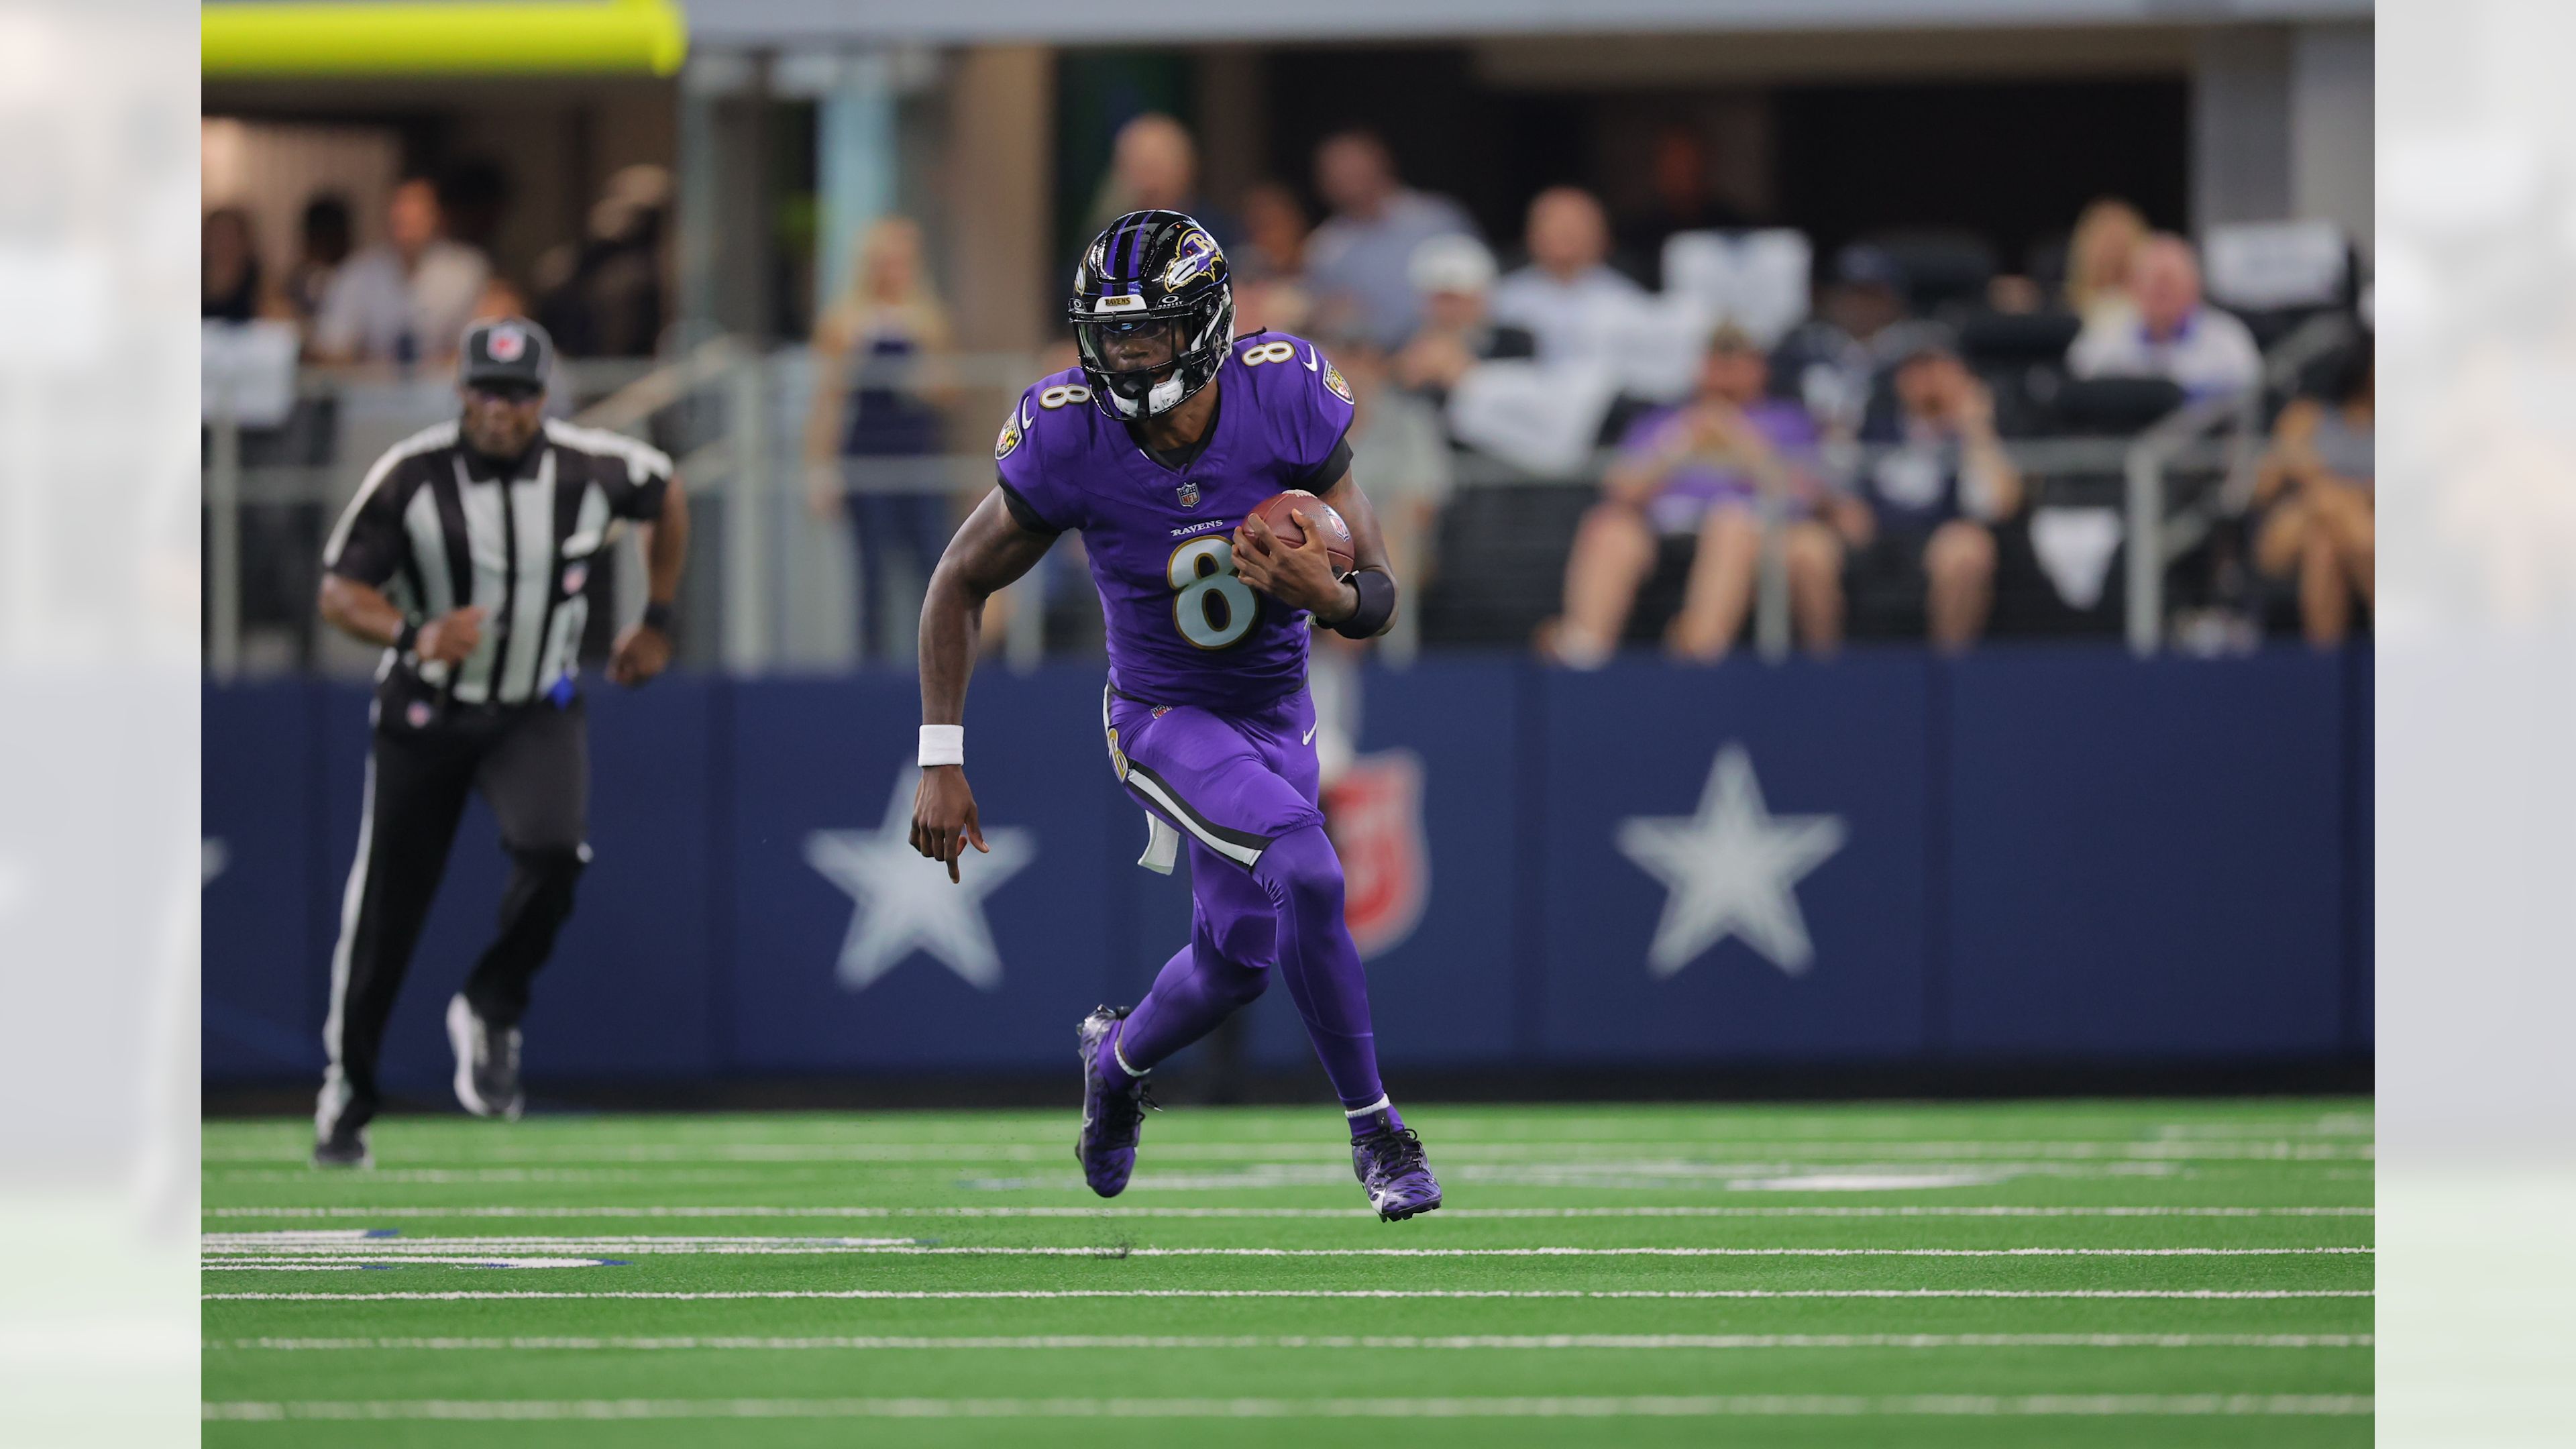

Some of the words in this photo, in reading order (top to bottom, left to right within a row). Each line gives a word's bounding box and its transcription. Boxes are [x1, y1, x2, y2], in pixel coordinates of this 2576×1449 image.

[1104, 297, 1131, 306] RAVENS
[1242, 341, 1296, 367] 8
[1040, 384, 1091, 409] 8
[1182, 492, 1197, 504] NFL
[1170, 520, 1224, 537] RAVENS
[1167, 535, 1259, 650] 8
